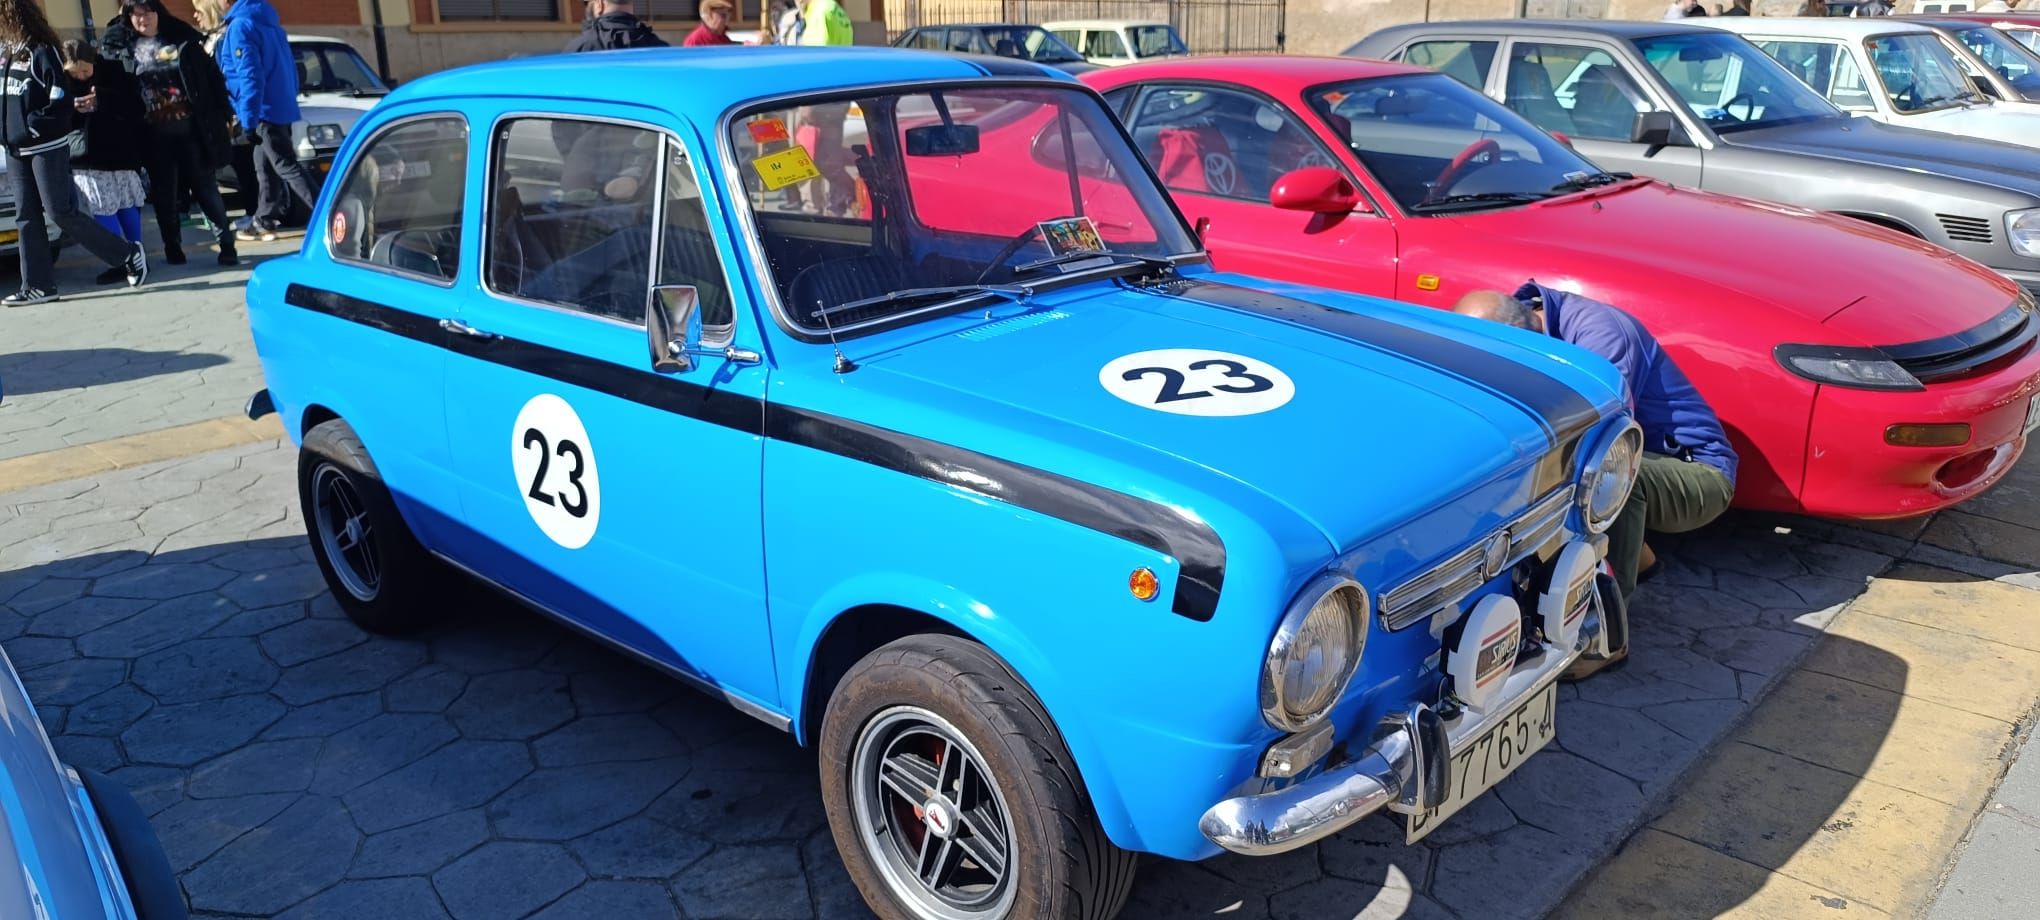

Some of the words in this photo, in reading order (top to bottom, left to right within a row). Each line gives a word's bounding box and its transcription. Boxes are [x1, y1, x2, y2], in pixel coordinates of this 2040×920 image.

[1122, 359, 1274, 404] 23
[523, 427, 588, 518] 23
[1491, 631, 1518, 664] SIRIUS
